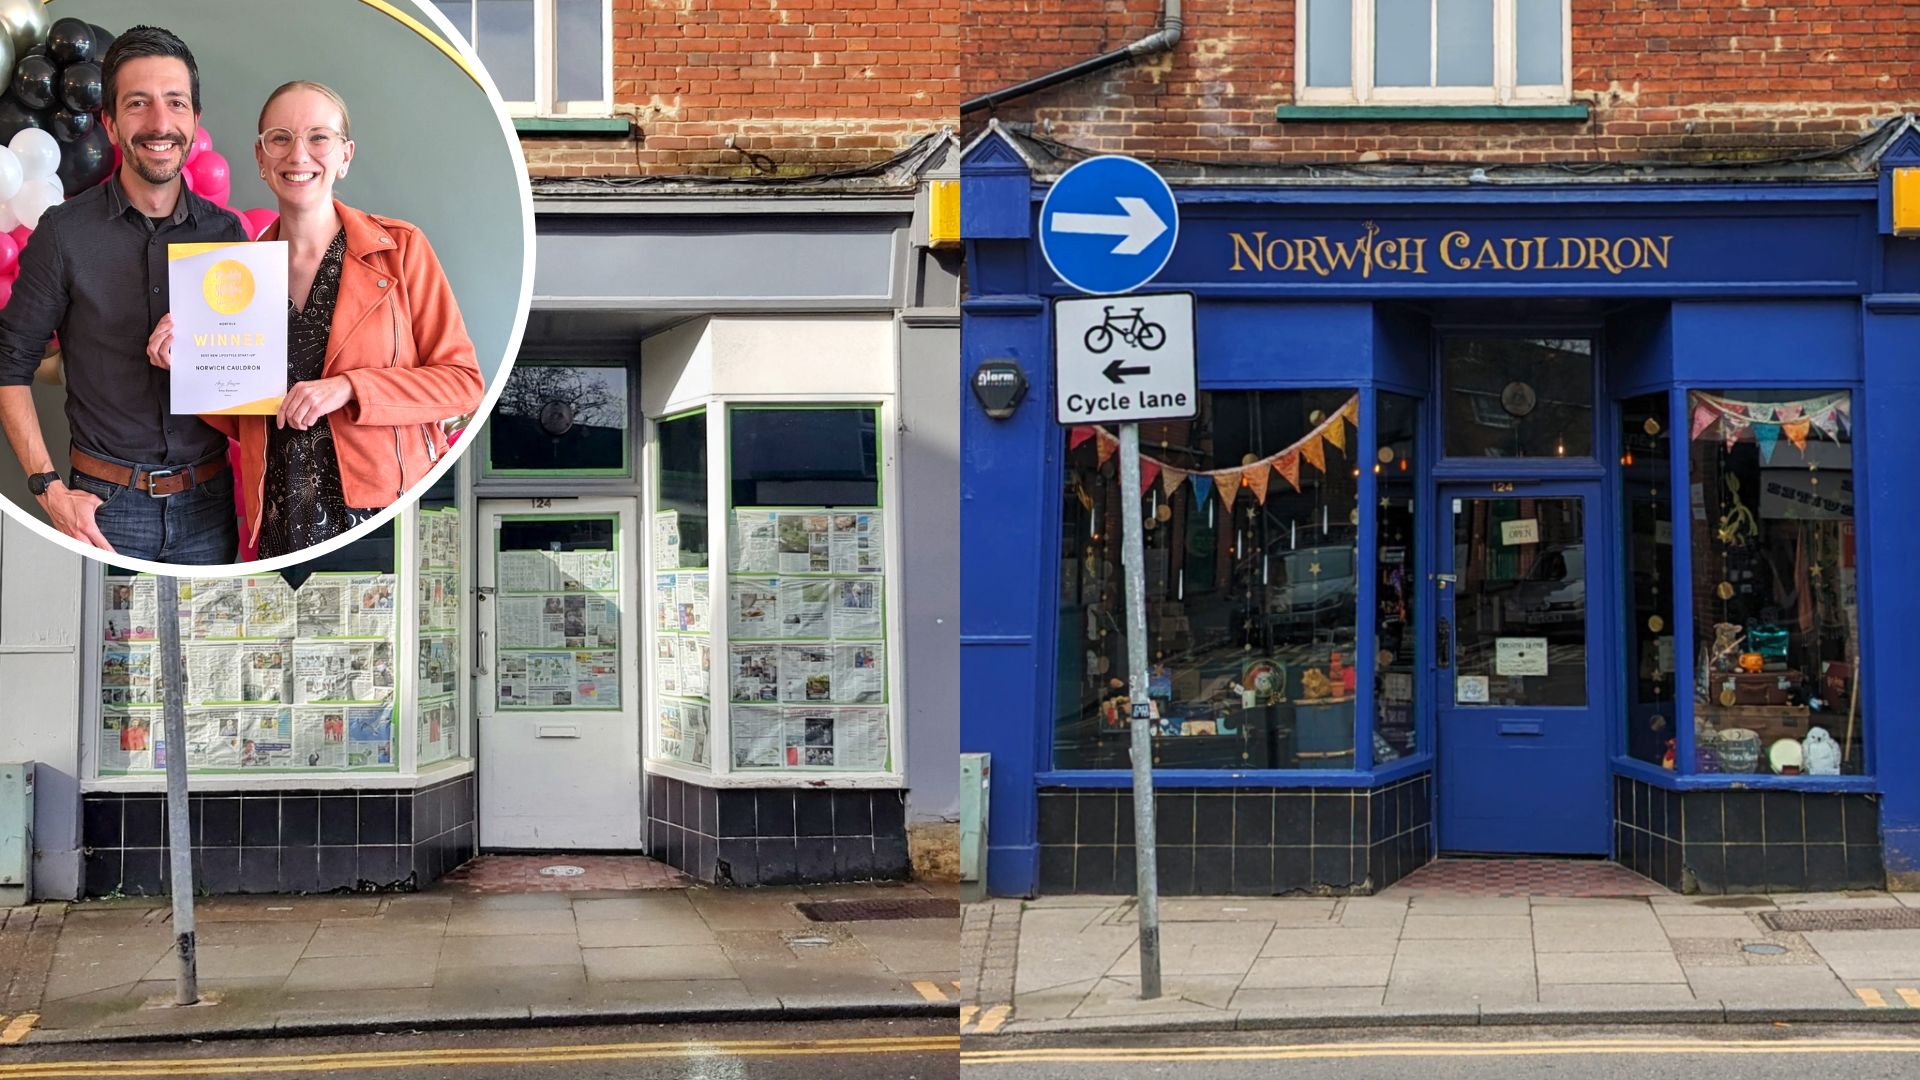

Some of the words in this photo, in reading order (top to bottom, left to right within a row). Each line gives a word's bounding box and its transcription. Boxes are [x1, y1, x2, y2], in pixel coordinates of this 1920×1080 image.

[1229, 224, 1428, 278] NORWICH
[1440, 231, 1674, 274] CAULDRON
[193, 333, 265, 347] WINNER
[1066, 392, 1131, 414] Cycle
[1139, 390, 1187, 409] lane
[1493, 482, 1513, 492] 124
[531, 497, 551, 508] 124
